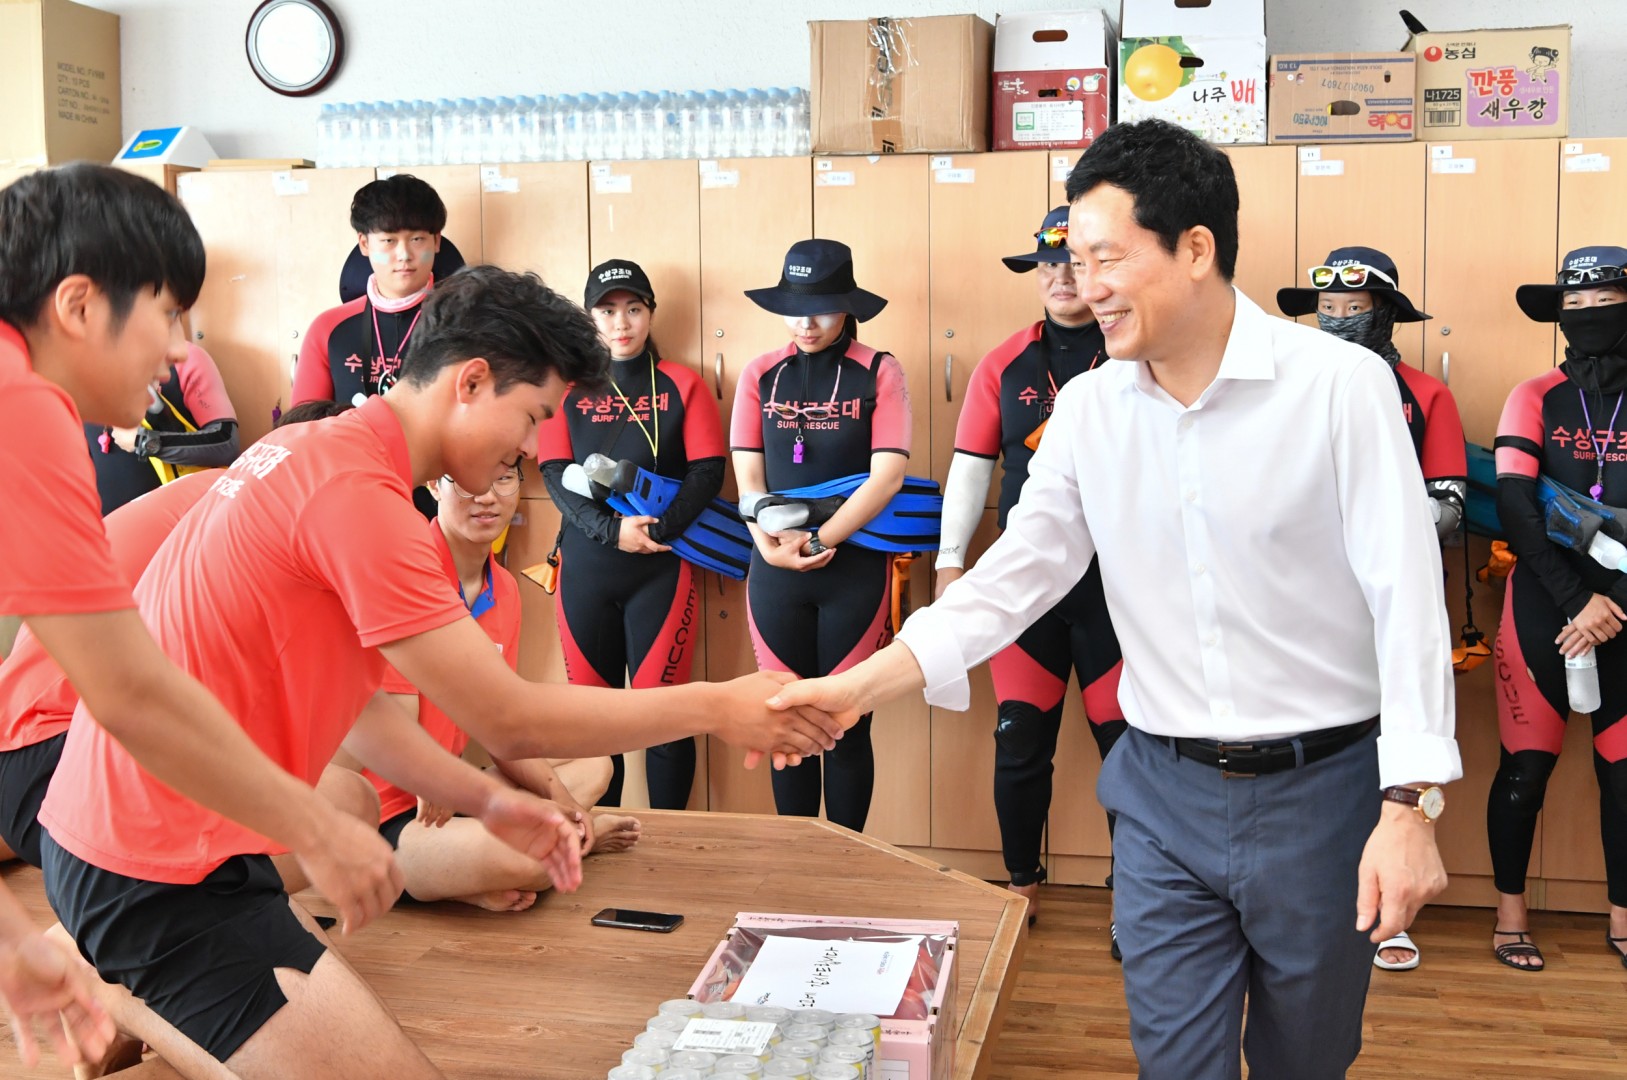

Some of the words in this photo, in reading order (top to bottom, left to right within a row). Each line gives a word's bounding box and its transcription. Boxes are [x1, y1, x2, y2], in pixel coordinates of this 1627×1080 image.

[1444, 47, 1476, 60] 농심
[1193, 87, 1226, 103] 나주
[1231, 78, 1255, 104] 배
[1470, 69, 1517, 96] 깐풍
[1426, 89, 1460, 101] 나1725
[1480, 98, 1546, 120] 새우깡
[1368, 113, 1412, 130] Dole
[598, 268, 632, 280] 수상구조대
[576, 392, 669, 415] 수상구조대
